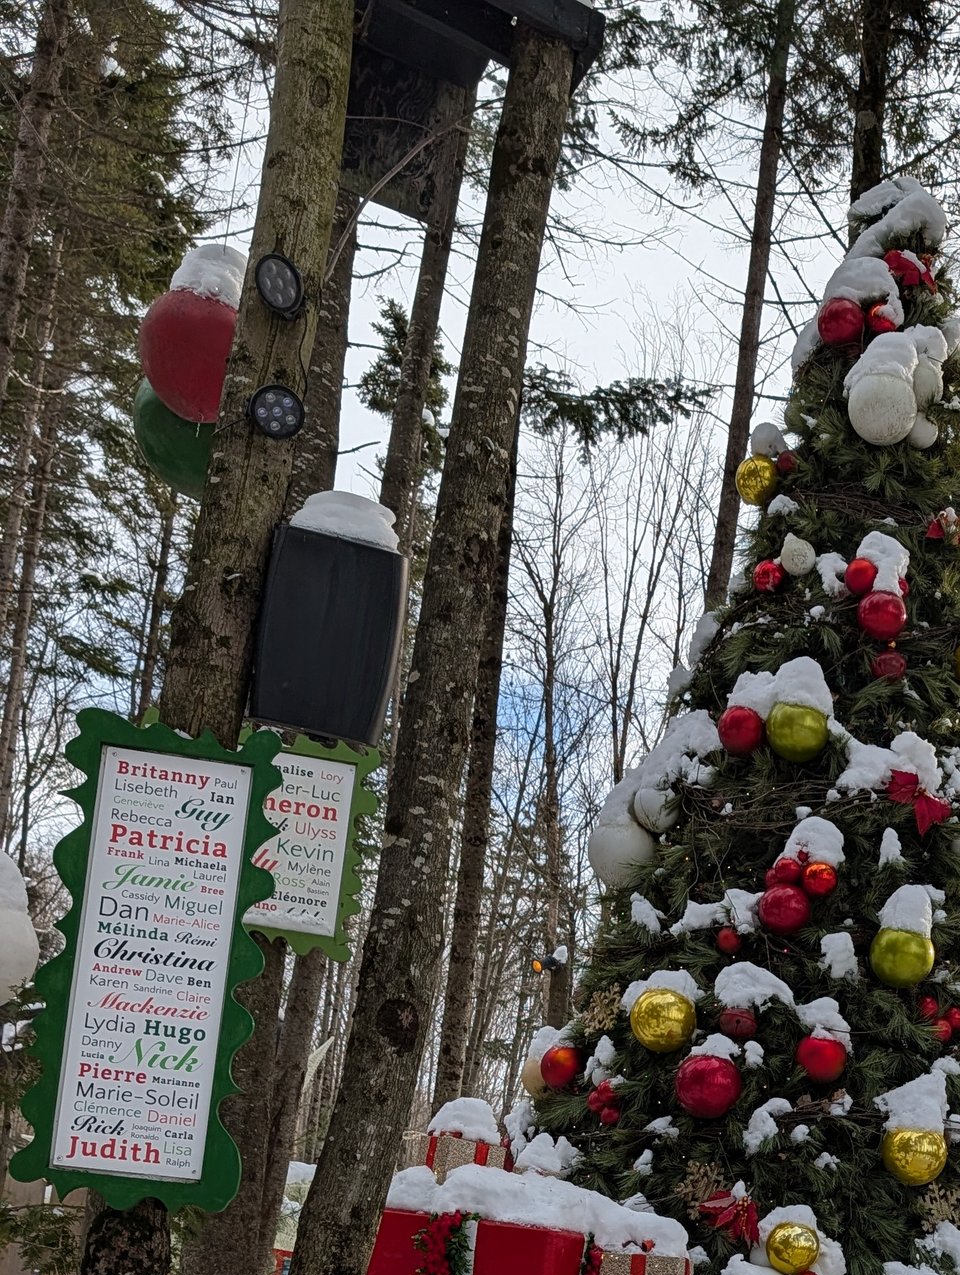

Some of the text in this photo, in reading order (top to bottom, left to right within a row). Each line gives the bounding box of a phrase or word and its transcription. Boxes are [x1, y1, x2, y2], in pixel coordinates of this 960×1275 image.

[117, 760, 238, 790] Britanny Paul
[321, 770, 344, 785] Lory
[115, 778, 235, 805] Lisebeth Ian
[111, 808, 173, 828] Rebecca
[113, 795, 234, 832] Geneviève Guy
[109, 824, 228, 858] Patricia
[295, 821, 337, 840] Ulyss
[107, 846, 227, 872] Frank Lina Michaela
[276, 838, 334, 862] Kevin
[102, 863, 227, 892] Jamie Laurel
[273, 872, 331, 888] Ross Alain
[287, 861, 331, 877] Mylène
[121, 889, 223, 917] Cassidy Miguel
[200, 885, 225, 896] Bree
[99, 896, 220, 931] Dan Marie-Alice
[97, 921, 218, 948] Mélinda Rémi
[93, 937, 218, 972] Christina
[92, 962, 212, 988] Andrew Dave Ben
[89, 974, 211, 1004] Karen Sandrine Claire
[87, 991, 211, 1021] Mackenzie
[84, 1012, 206, 1045] Lydia Hugo
[81, 1035, 204, 1073] Danny Nick
[78, 1062, 201, 1089] Pierre Marianne
[76, 1081, 199, 1110] Marie-Soleil
[73, 1100, 197, 1127] Clémence Daniel
[70, 1115, 194, 1141] Rick Joaquim Carla
[131, 1132, 160, 1141] Ronaldo
[66, 1135, 192, 1164] Judith Lisa
[165, 1158, 191, 1169] Ralph
